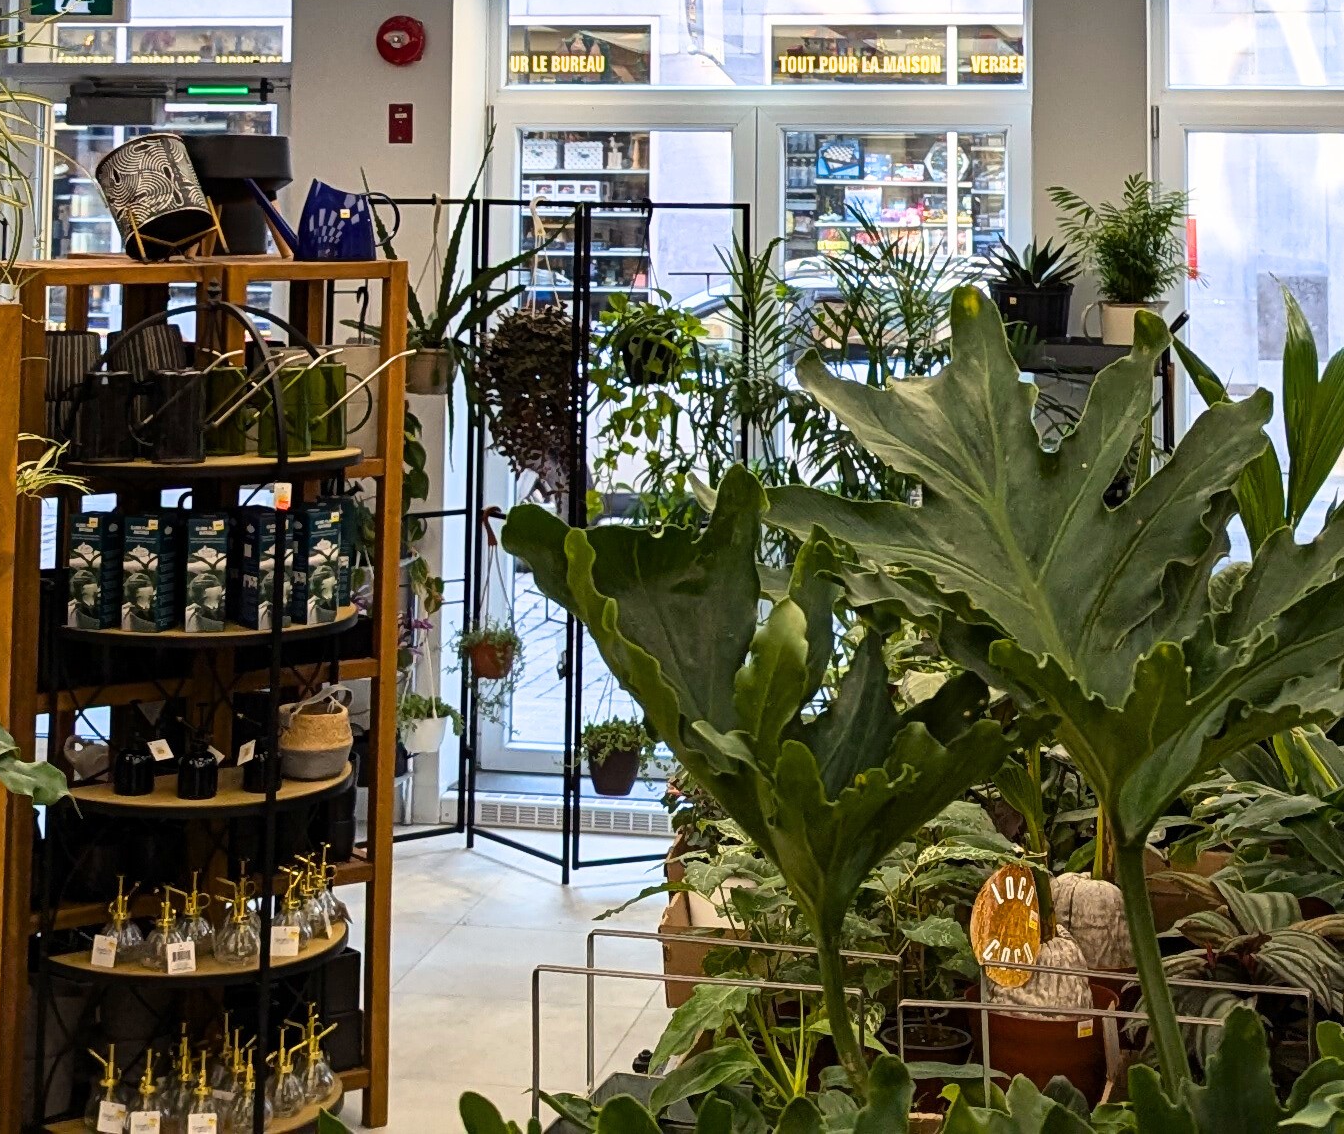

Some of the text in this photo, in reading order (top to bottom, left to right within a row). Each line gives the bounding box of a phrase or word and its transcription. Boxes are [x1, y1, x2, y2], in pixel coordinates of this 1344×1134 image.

[532, 55, 548, 73] LE
[551, 55, 605, 73] BUREAU
[778, 55, 942, 74] TOUT POUR LA MAISON
[990, 876, 1035, 907] LOCO
[982, 938, 1034, 972] COCO
